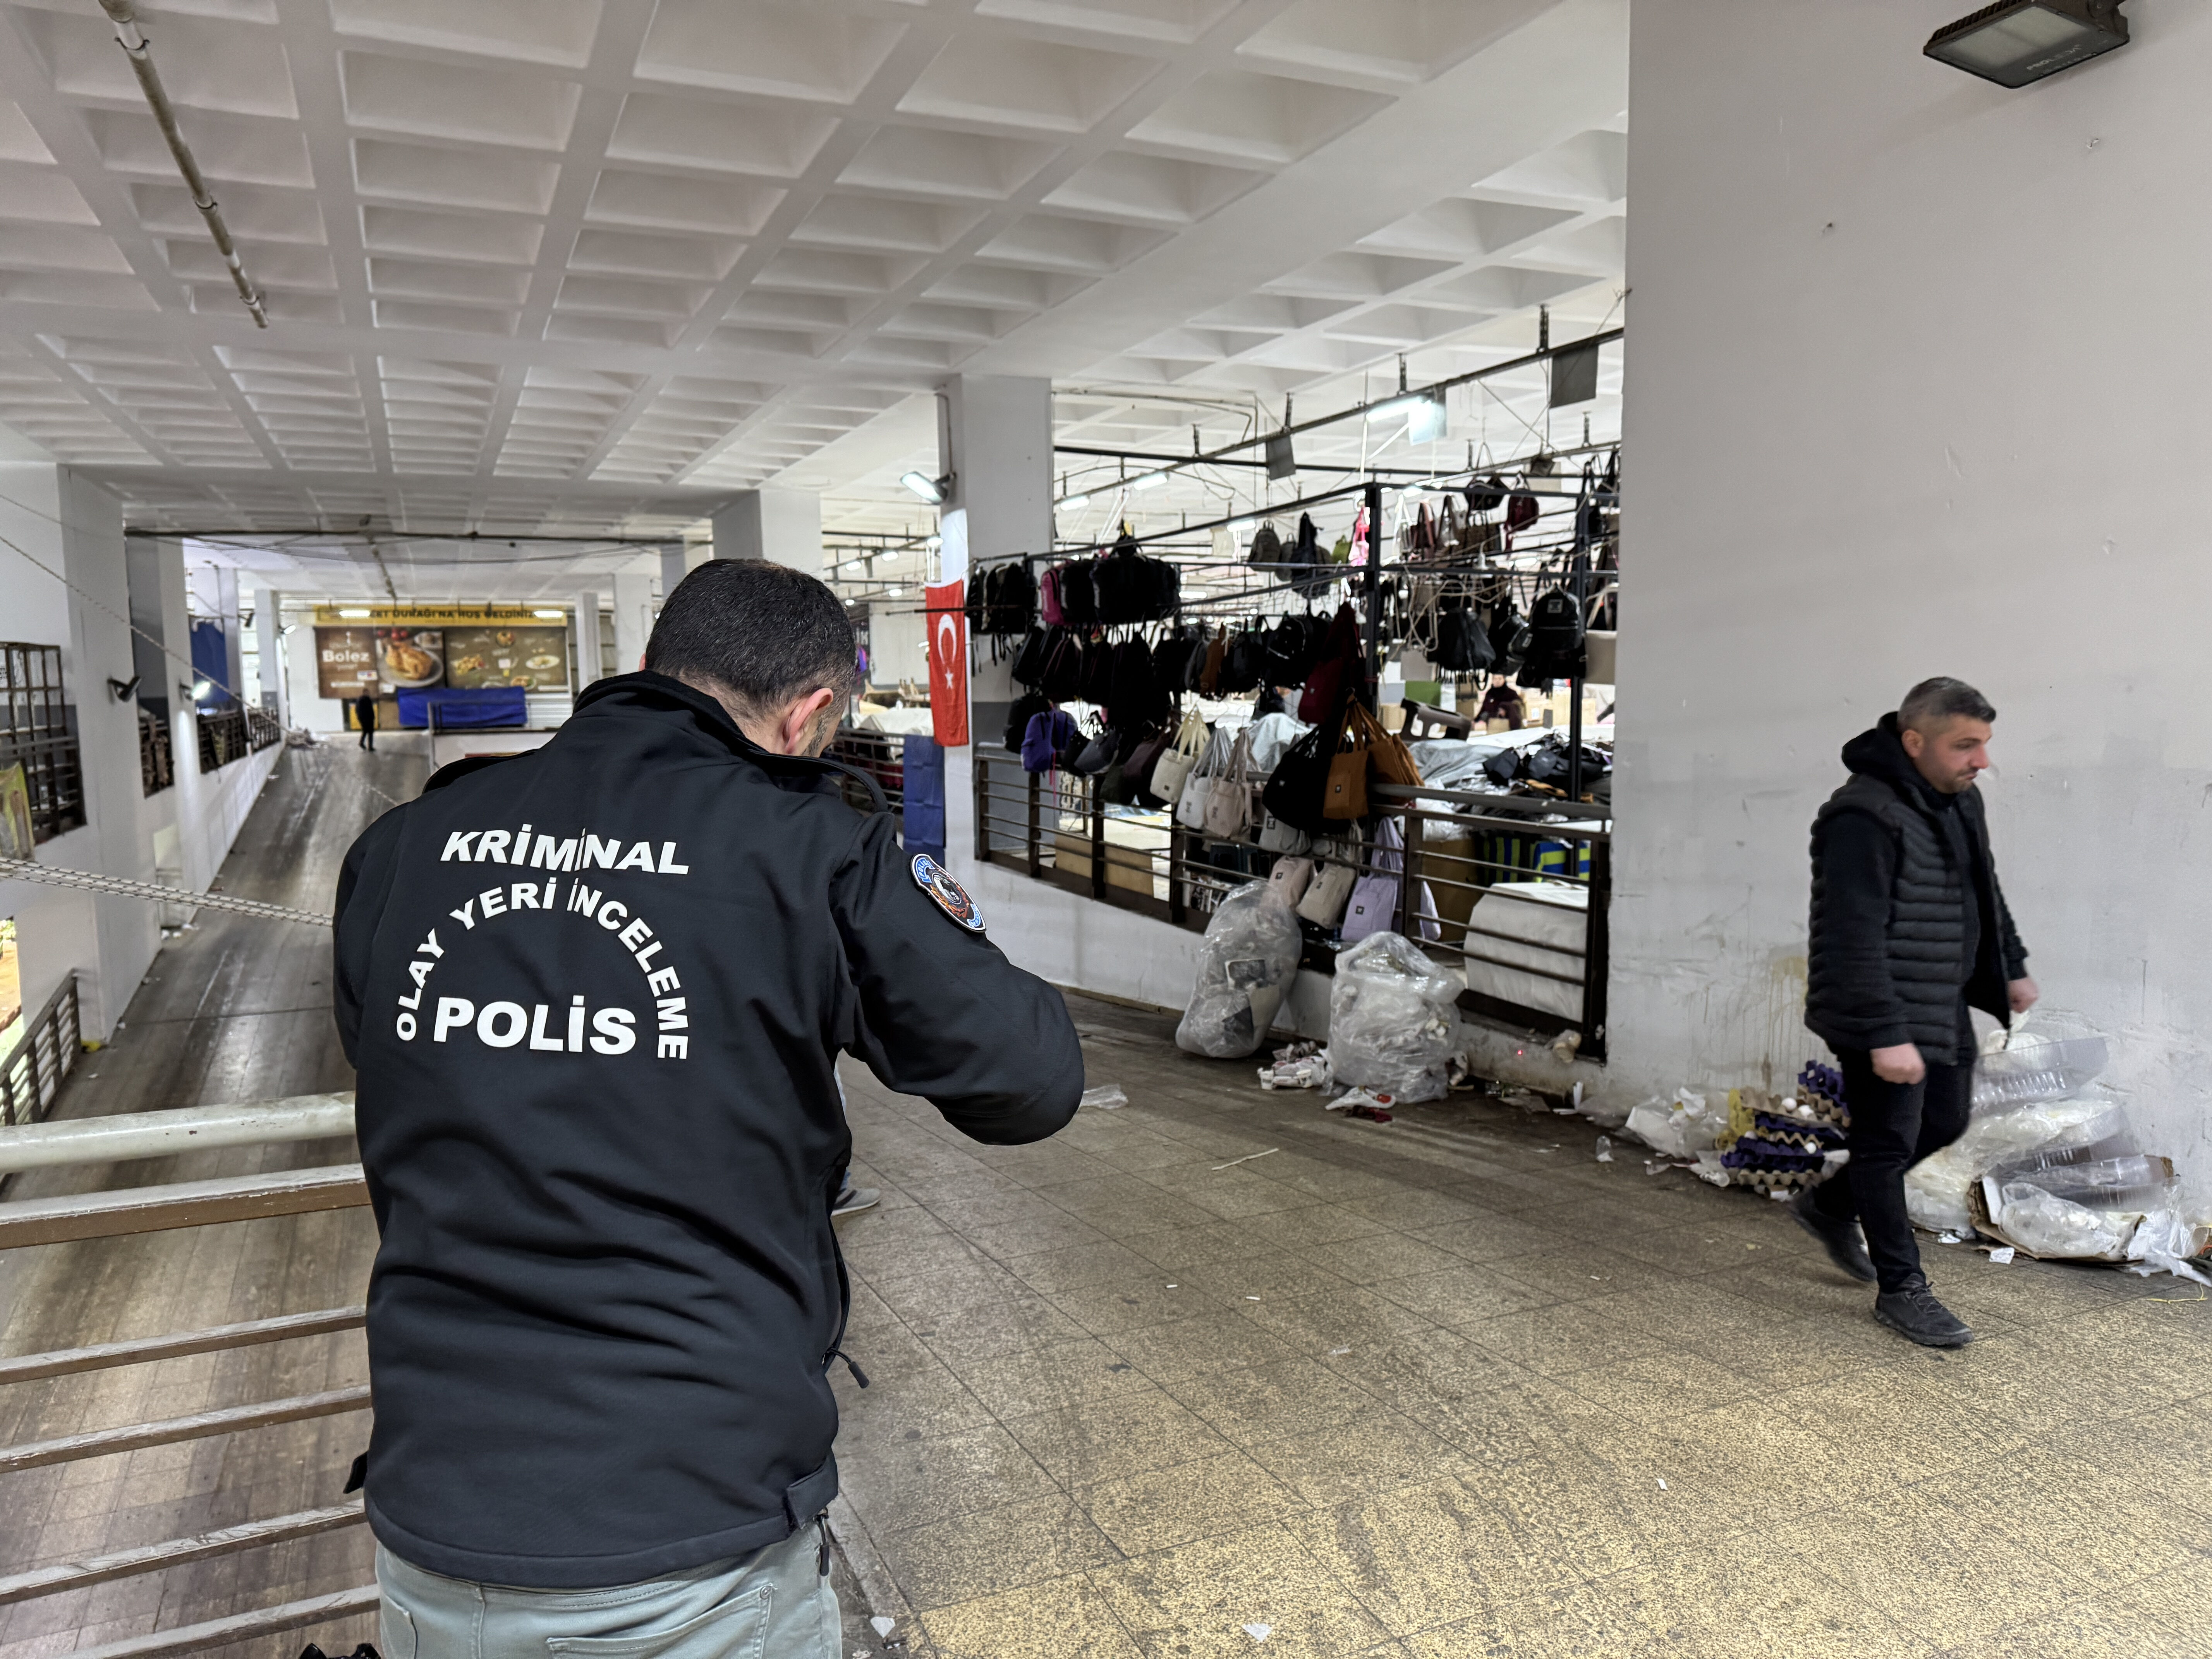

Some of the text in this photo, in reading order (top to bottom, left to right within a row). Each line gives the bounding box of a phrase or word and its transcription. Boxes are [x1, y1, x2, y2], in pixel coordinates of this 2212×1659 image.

[322, 649, 370, 663] Bolez
[440, 823, 689, 875] KRİMİNAL
[396, 877, 689, 1059] OLAY YERİ İNCELEME
[433, 995, 637, 1055] POLİS
